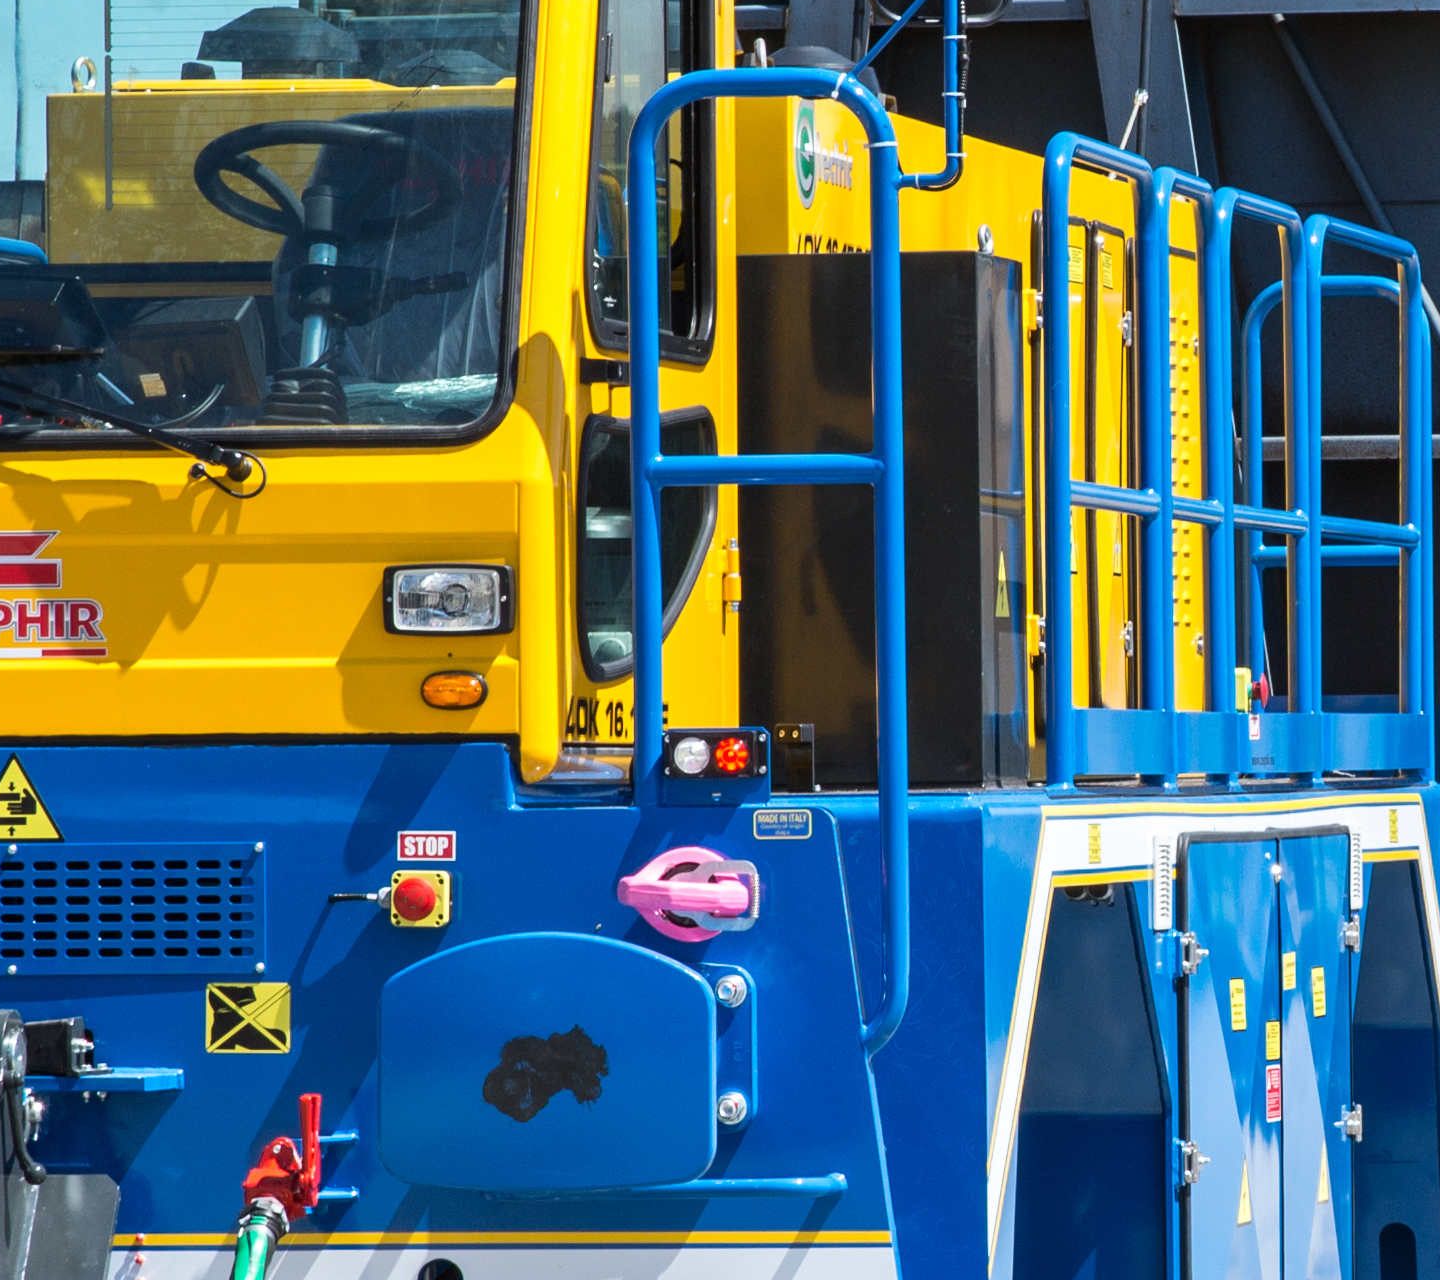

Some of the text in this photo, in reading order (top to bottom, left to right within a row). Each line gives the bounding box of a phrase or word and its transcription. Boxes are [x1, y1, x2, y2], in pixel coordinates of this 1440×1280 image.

[779, 814, 788, 822] IN
[789, 813, 808, 822] ITALY
[402, 835, 449, 858] STOP
